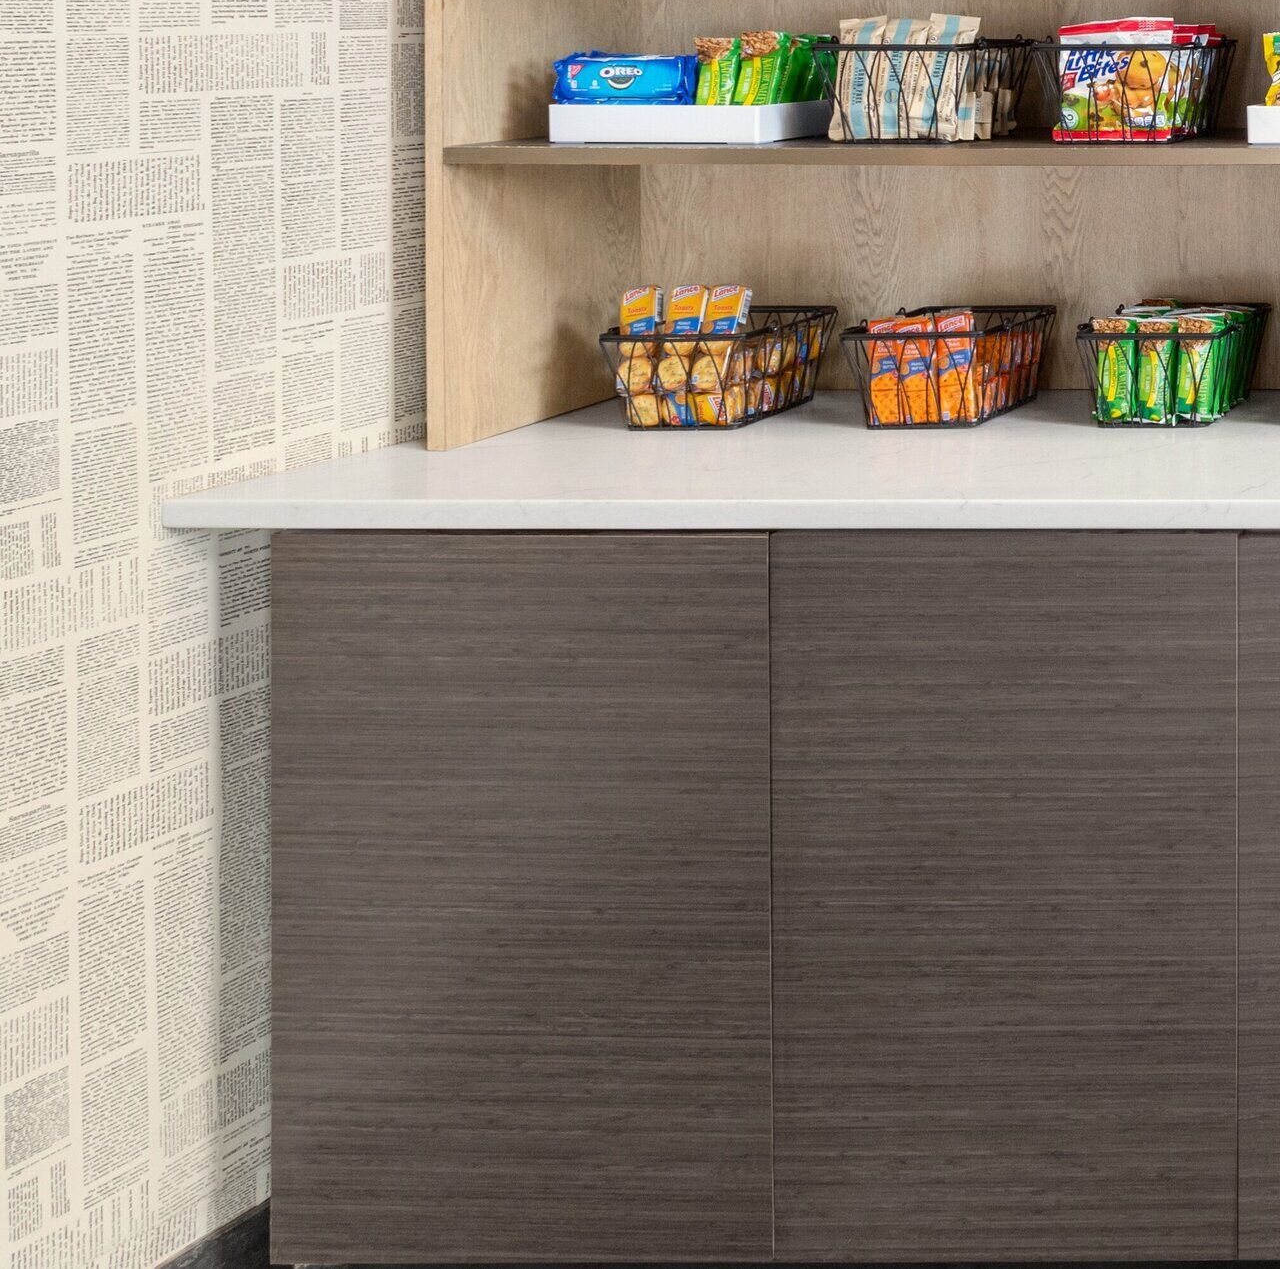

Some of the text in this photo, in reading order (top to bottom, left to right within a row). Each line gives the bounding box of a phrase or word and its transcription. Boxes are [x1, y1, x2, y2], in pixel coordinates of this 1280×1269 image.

[600, 66, 643, 78] OREO
[1078, 56, 1130, 82] Bites
[624, 287, 648, 302] Lance
[673, 285, 699, 298] Lance
[713, 285, 739, 298] Lance
[939, 316, 965, 332] Lance
